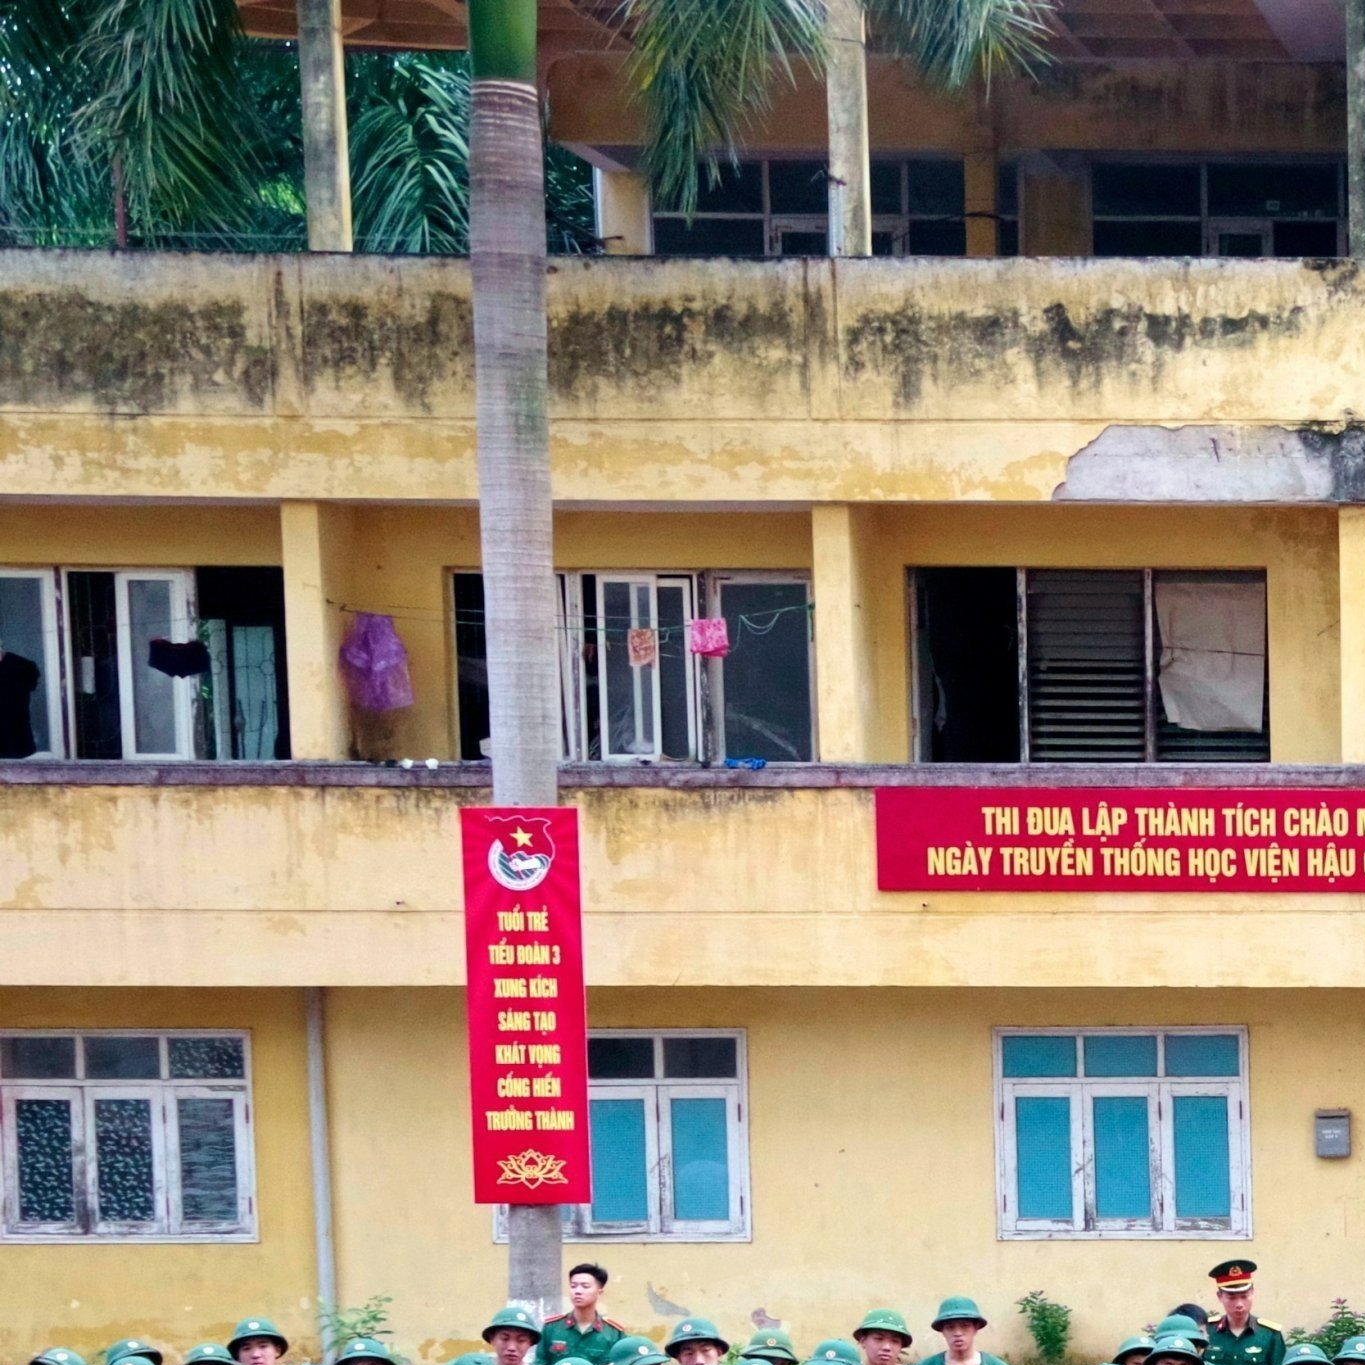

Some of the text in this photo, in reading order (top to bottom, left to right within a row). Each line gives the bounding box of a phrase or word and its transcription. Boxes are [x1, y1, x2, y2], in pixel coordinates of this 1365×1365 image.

[982, 806, 1019, 836] THI
[1027, 806, 1075, 836] ĐUA
[1083, 801, 1127, 843] LẬP
[1135, 801, 1215, 837] THÀNH
[1222, 802, 1276, 837] TÍCH
[1284, 802, 1348, 837] CHÀO
[928, 840, 992, 876] NGÀY
[1000, 838, 1093, 876] TRUYỀN
[1101, 838, 1180, 877] THỐNG
[1189, 847, 1236, 883] HỌC
[1244, 842, 1299, 883] VIỆN
[1308, 842, 1355, 883] HẬU
[497, 903, 550, 932] TUỔI TRẺ
[488, 936, 561, 965] TIỂU ĐOÀN 3
[493, 974, 558, 998] XUNG KÍCH
[497, 1007, 557, 1036] SÁNG TẠO
[495, 1040, 561, 1069] KHÁT VỌNG
[497, 1071, 562, 1098] CỐNG HIẾN
[485, 1104, 575, 1131] TRƯỞNG THÀNH
